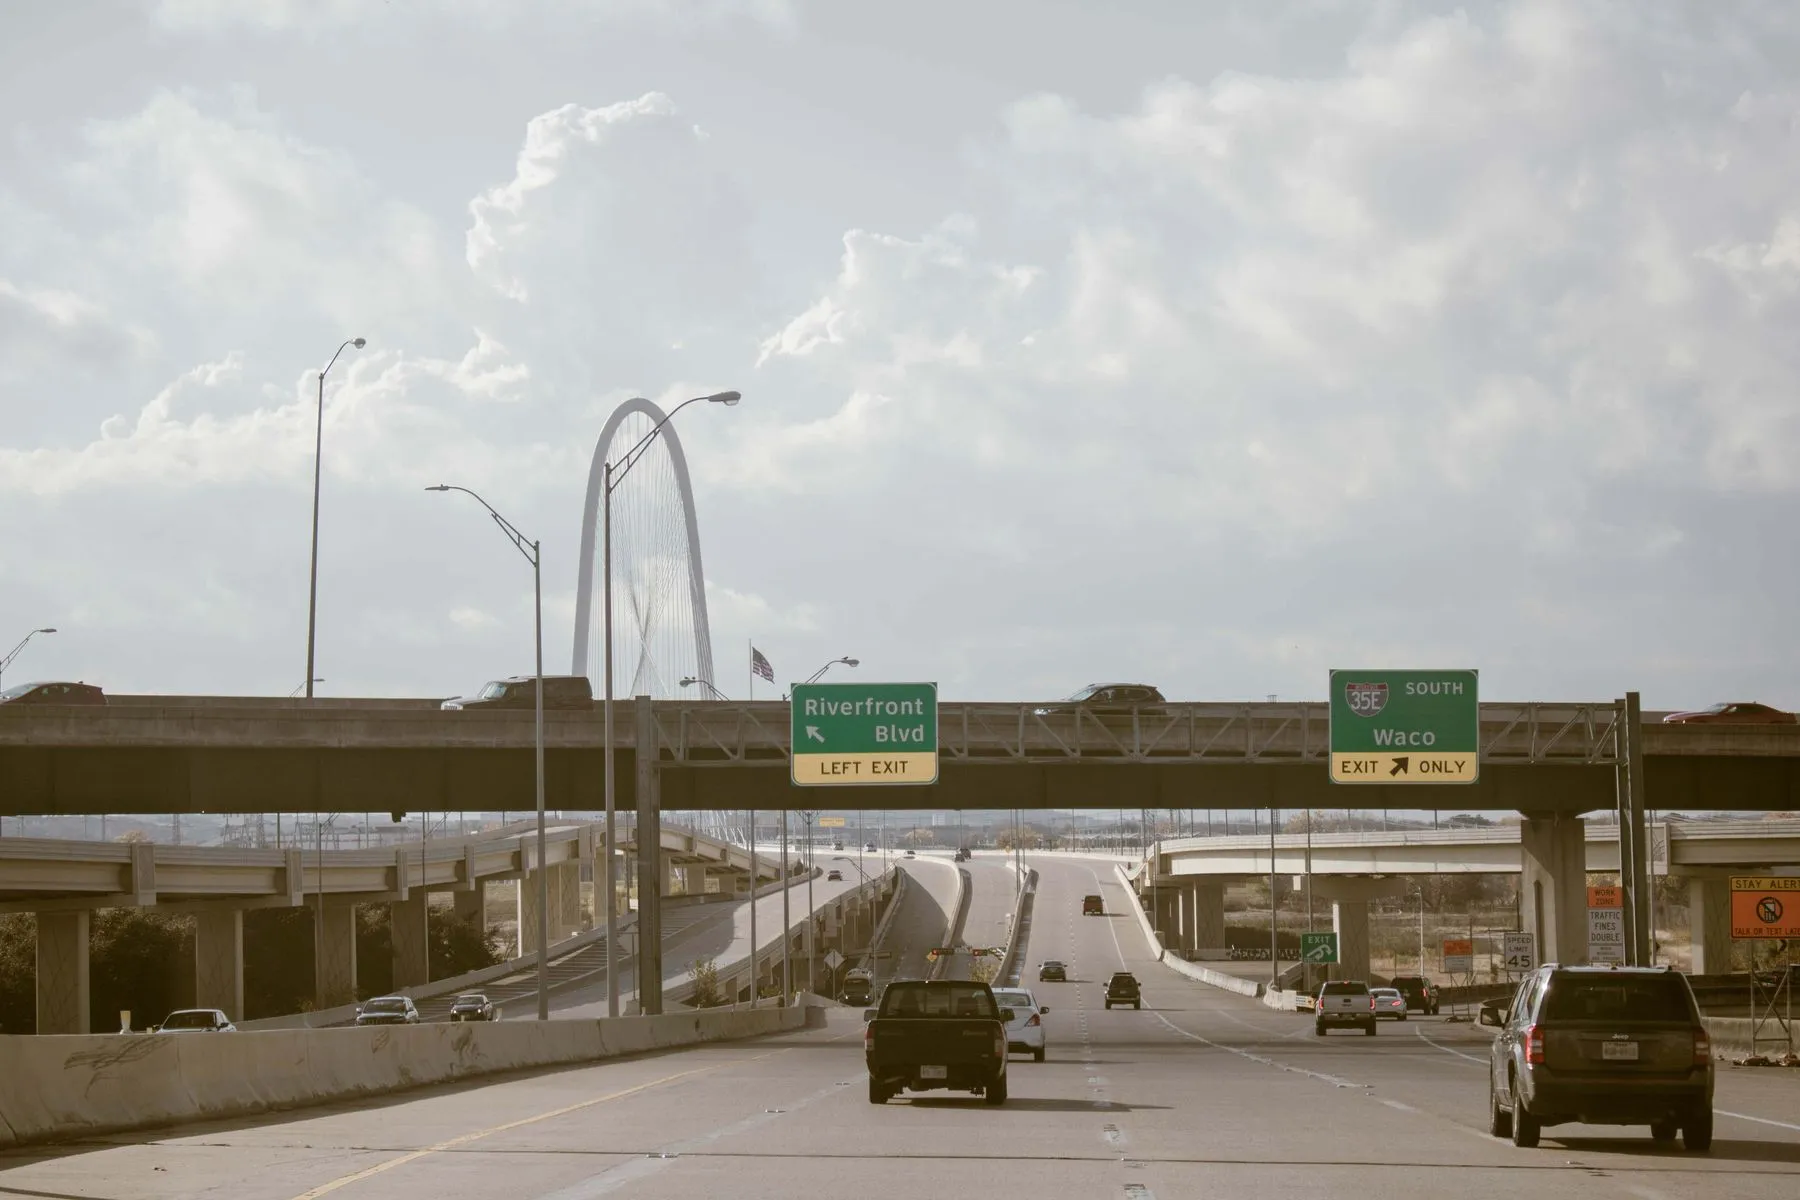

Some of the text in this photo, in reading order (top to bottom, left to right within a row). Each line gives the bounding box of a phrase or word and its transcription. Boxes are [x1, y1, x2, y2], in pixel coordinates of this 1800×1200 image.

[1405, 681, 1463, 695] SOUTH
[1351, 691, 1381, 710] 35E
[805, 697, 924, 716] Riverfront
[875, 724, 924, 742] Blvd
[1373, 728, 1436, 746] Waco
[821, 760, 908, 775] LEFT EXIT
[1342, 760, 1466, 774] EXIT ONLY
[1735, 879, 1762, 889] STAY
[1594, 889, 1616, 897] WORK
[1595, 897, 1615, 906] ZONE
[1590, 911, 1621, 920] TRAFFIC
[1594, 922, 1616, 931] FINES
[1734, 927, 1751, 935] TALK
[1753, 927, 1763, 935] OR
[1766, 927, 1782, 935] TEXT
[1308, 935, 1331, 944] EXIT
[1591, 933, 1621, 942] DOUBLE
[1508, 955, 1531, 968] 45
[1611, 1033, 1630, 1041] Jeep
